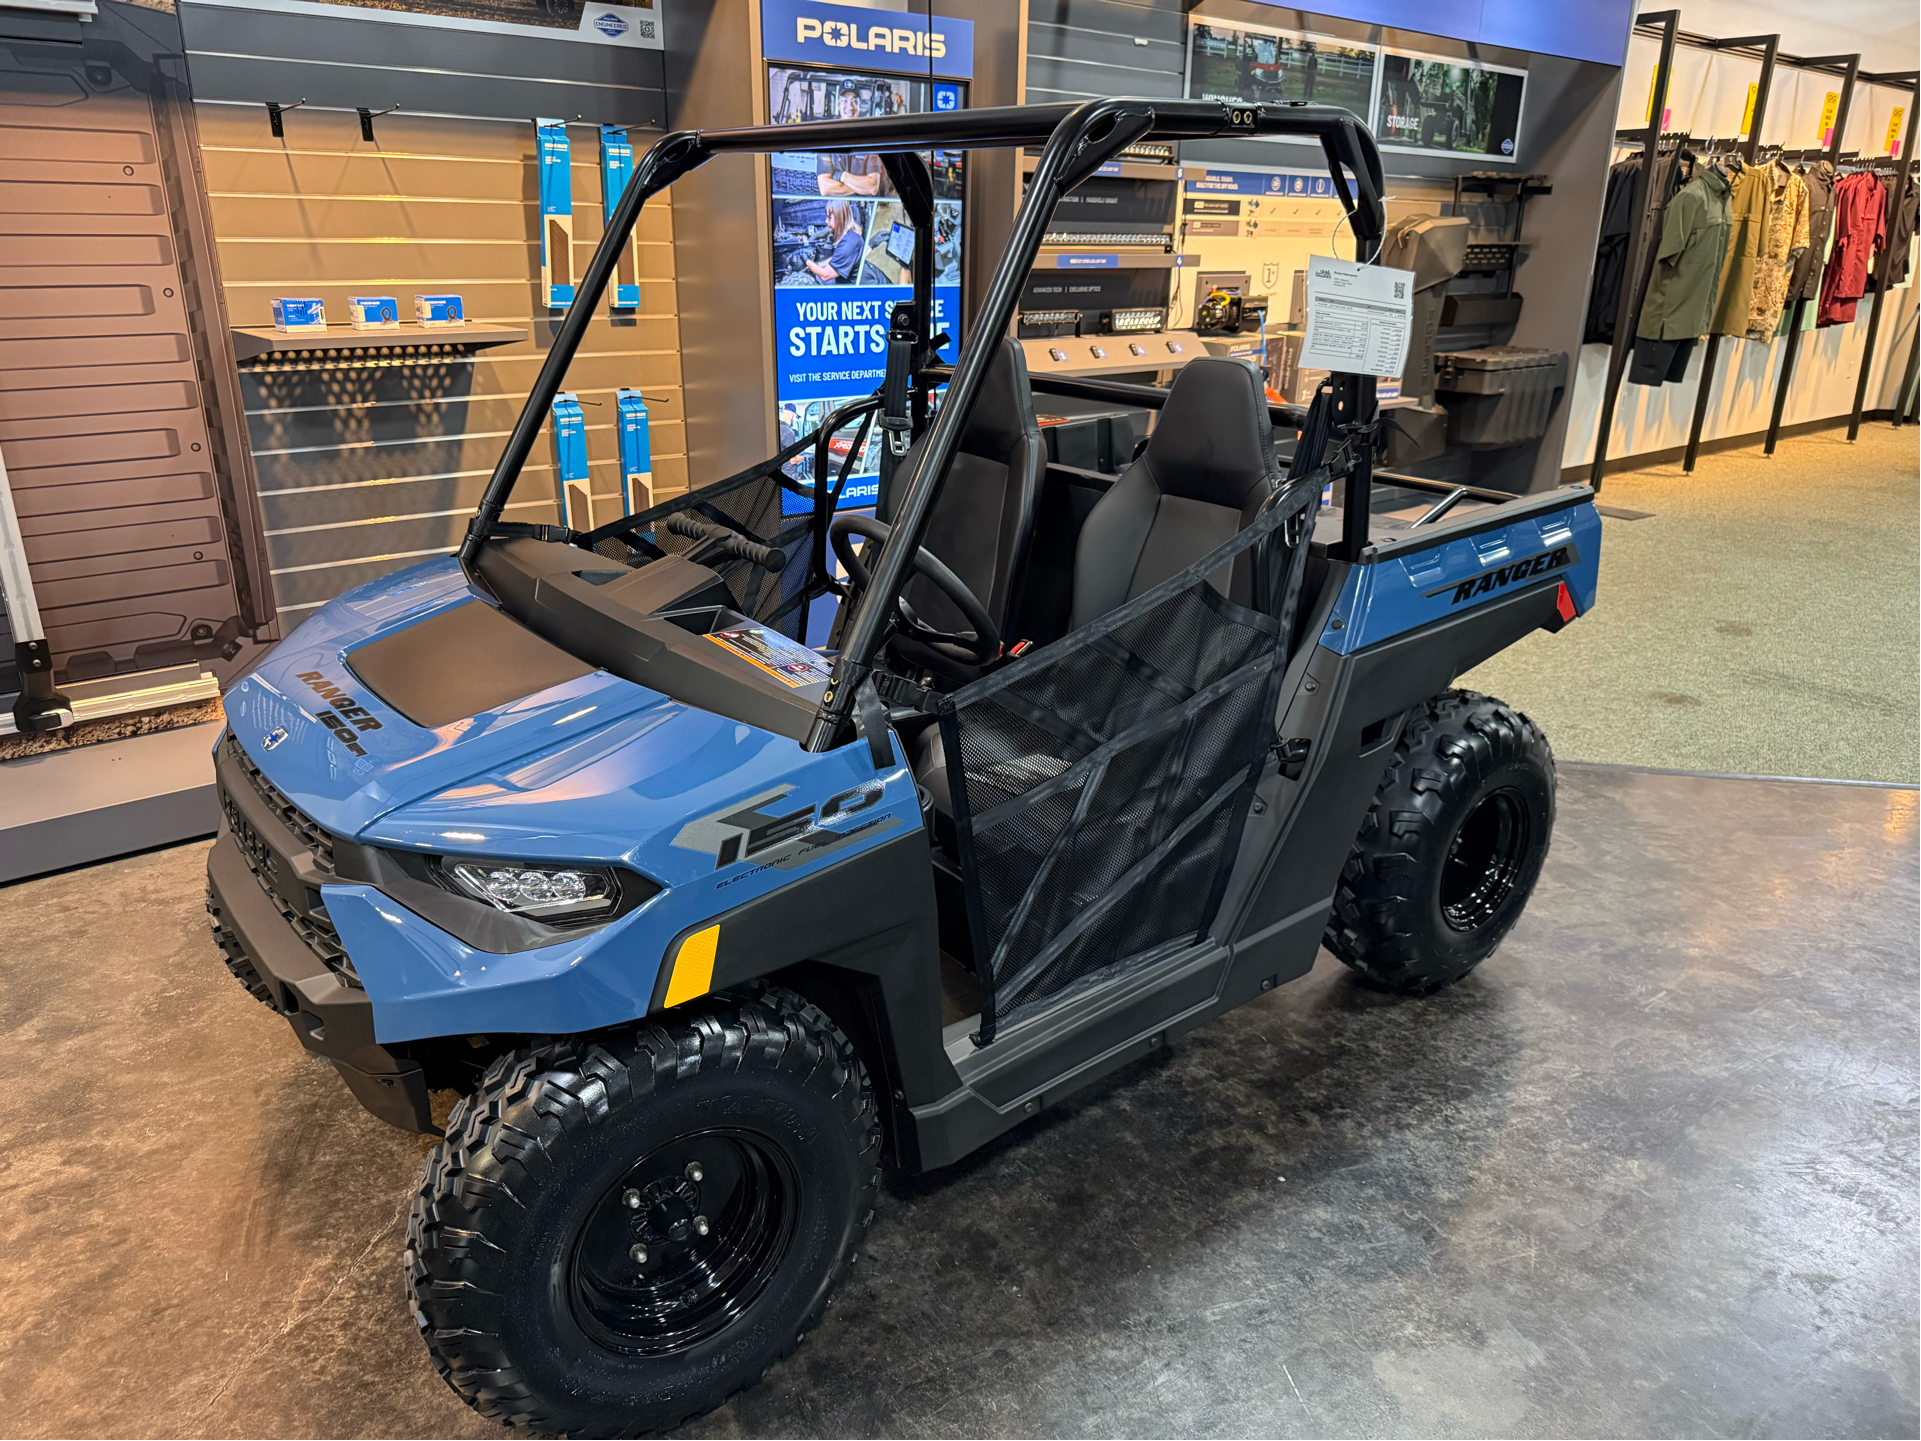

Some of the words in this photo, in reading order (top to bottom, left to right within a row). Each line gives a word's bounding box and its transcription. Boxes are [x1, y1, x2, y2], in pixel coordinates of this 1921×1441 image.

[796, 17, 947, 58] POLARIS
[1386, 114, 1418, 131] STORAGE
[796, 302, 838, 321] YOUR
[841, 301, 881, 320] NEXT
[789, 324, 886, 357] STARTS
[789, 374, 806, 383] VISIT
[808, 373, 821, 382] THE
[822, 371, 850, 381] SERVICE
[1452, 547, 1567, 605] RANGER
[295, 671, 384, 732] RANGER
[716, 854, 792, 889] ELECTRONIC
[797, 840, 829, 856] FUEL
[835, 812, 892, 840] INJECTION
